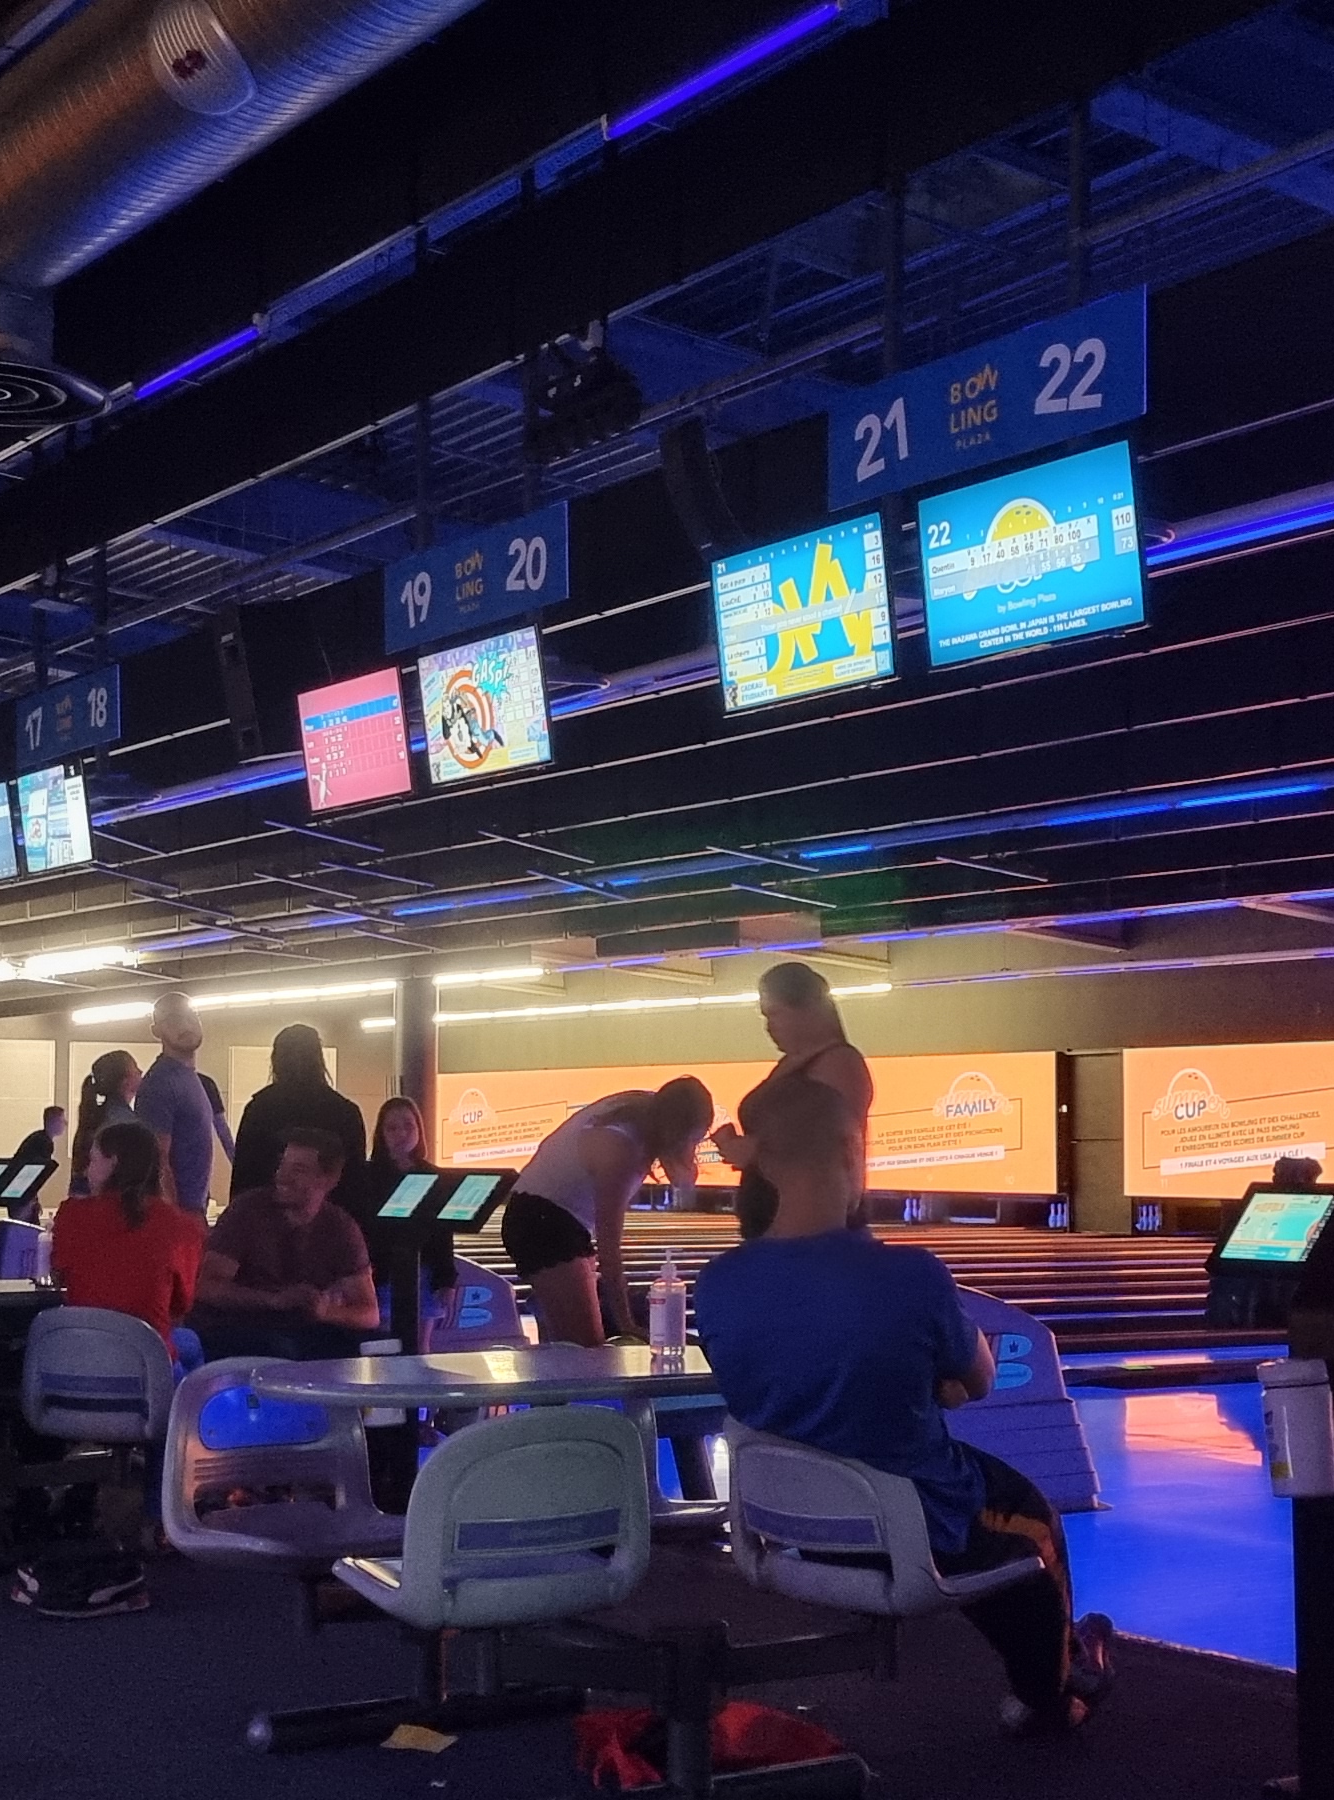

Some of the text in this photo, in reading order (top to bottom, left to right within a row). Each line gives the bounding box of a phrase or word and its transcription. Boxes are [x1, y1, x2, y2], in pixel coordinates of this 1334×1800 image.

[1034, 338, 1107, 415] 22
[951, 400, 998, 433] LING
[854, 397, 909, 483] 21
[1115, 512, 1131, 526] 110
[927, 521, 951, 550] 22
[1121, 536, 1133, 549] 73
[506, 536, 547, 591] 20
[871, 554, 881, 565] 16
[873, 573, 883, 584] 12
[401, 571, 432, 628] 19
[939, 639, 950, 648] THE
[1027, 617, 1047, 628] JAPAN
[1056, 611, 1069, 621] THE
[1069, 604, 1100, 619] LARGEST
[1100, 597, 1132, 612] BOWLING
[979, 636, 1004, 648] CENTER
[1012, 632, 1024, 642] THE
[1025, 627, 1048, 639] WORLD
[87, 687, 107, 728] 18
[25, 706, 42, 750] 17
[462, 1110, 483, 1125] CUP
[945, 1098, 997, 1118] FAMILY
[1174, 1100, 1206, 1120] CUP
